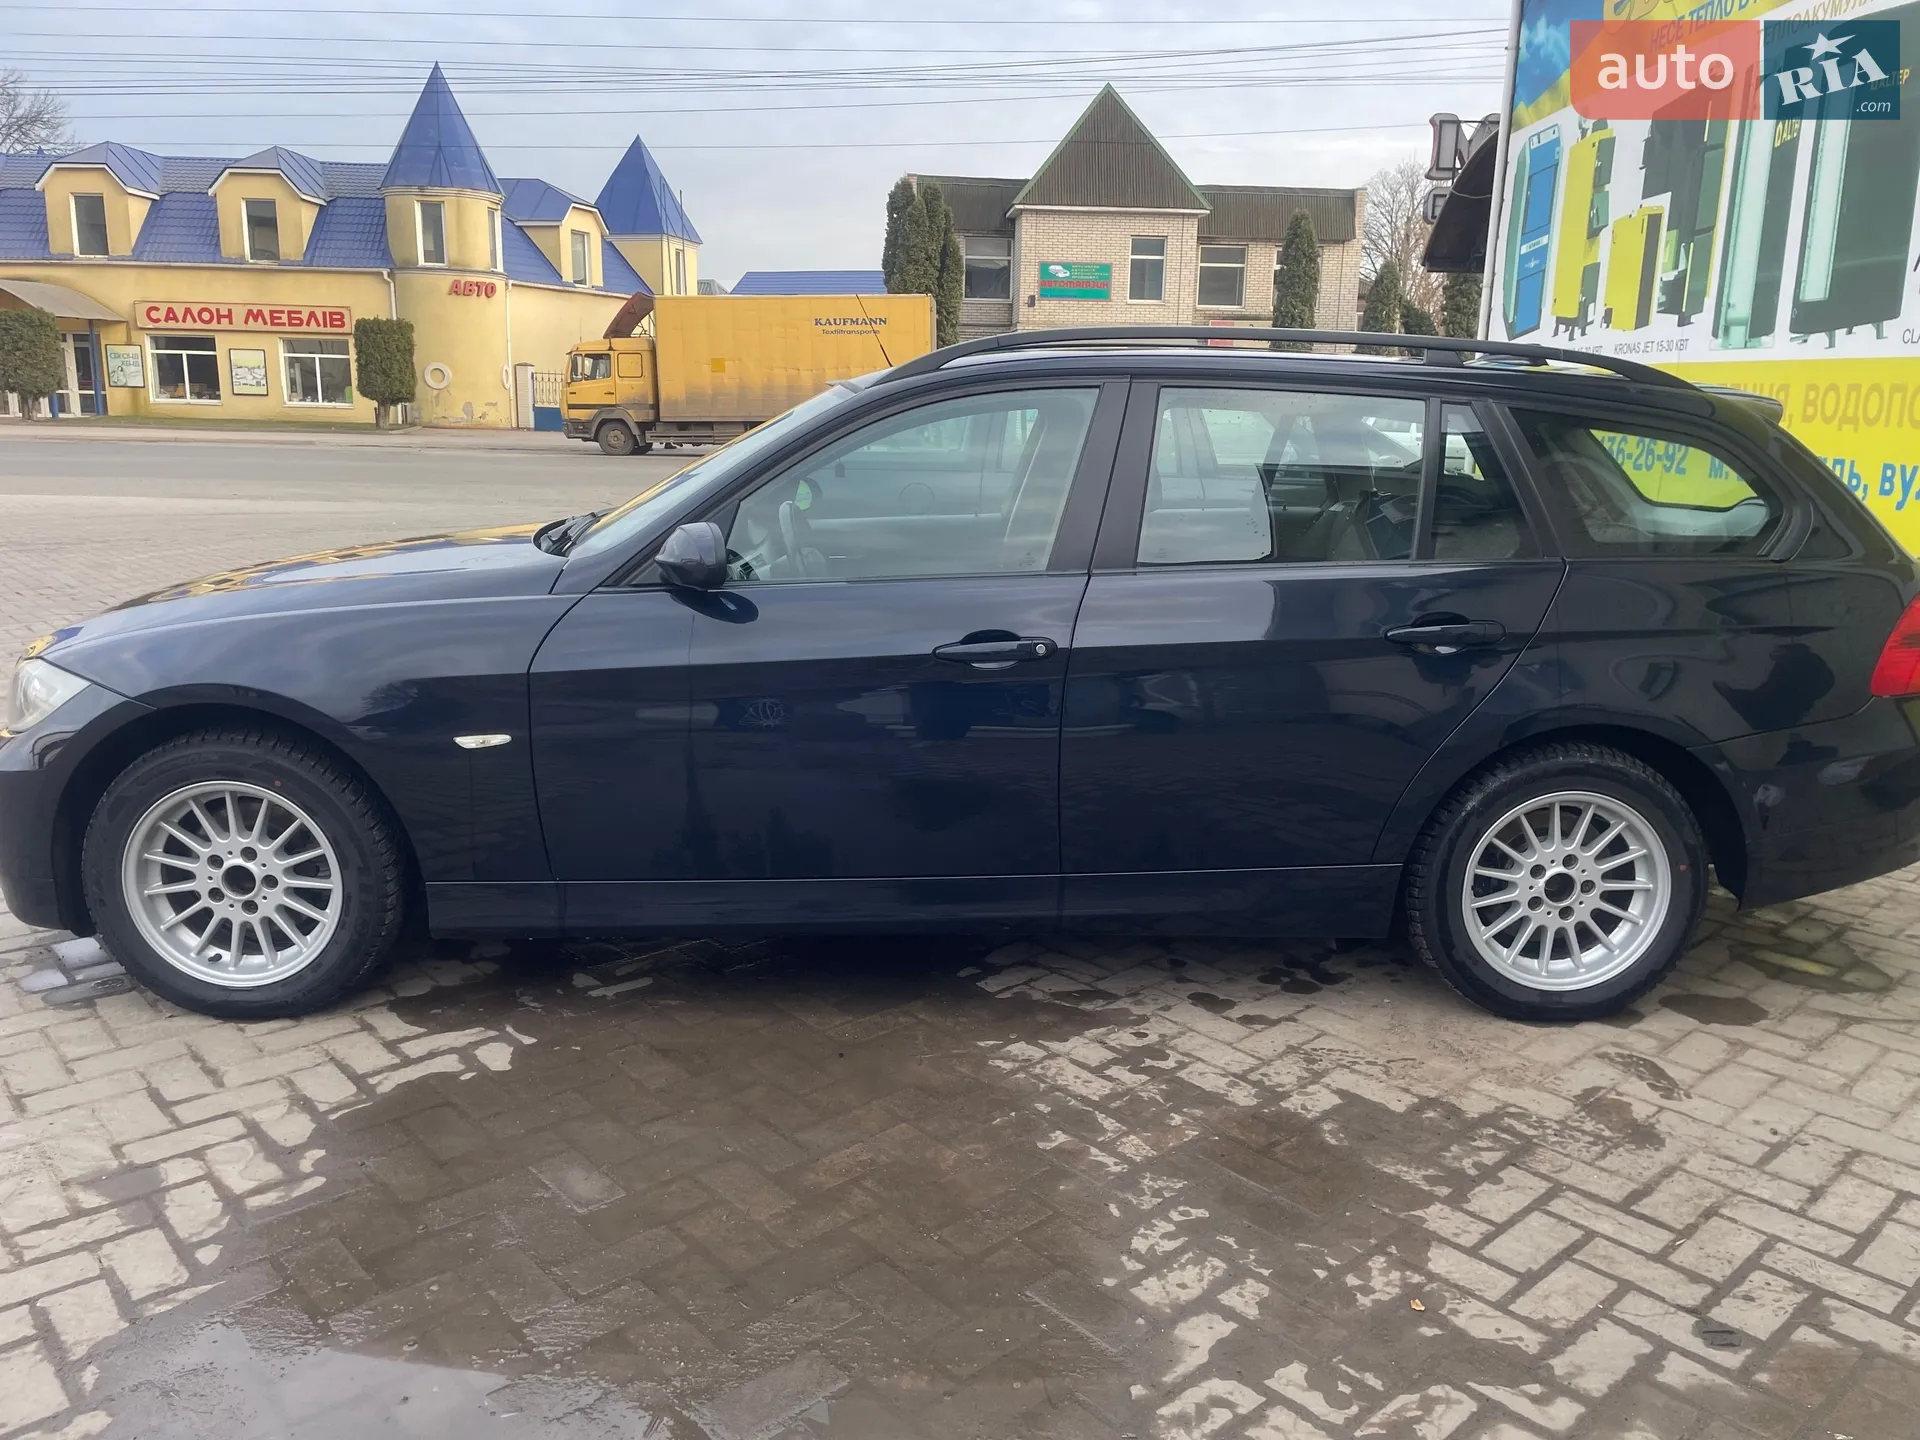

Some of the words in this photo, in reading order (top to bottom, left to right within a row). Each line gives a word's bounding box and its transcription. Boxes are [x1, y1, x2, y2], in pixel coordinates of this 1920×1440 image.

[448, 279, 497, 298] АВТО
[145, 306, 234, 325] САЛОН
[244, 308, 346, 328] МЕБЛІВ
[814, 317, 888, 326] KAUFMANN
[1614, 342, 1641, 355] KRONAS
[1641, 341, 1655, 353] JET
